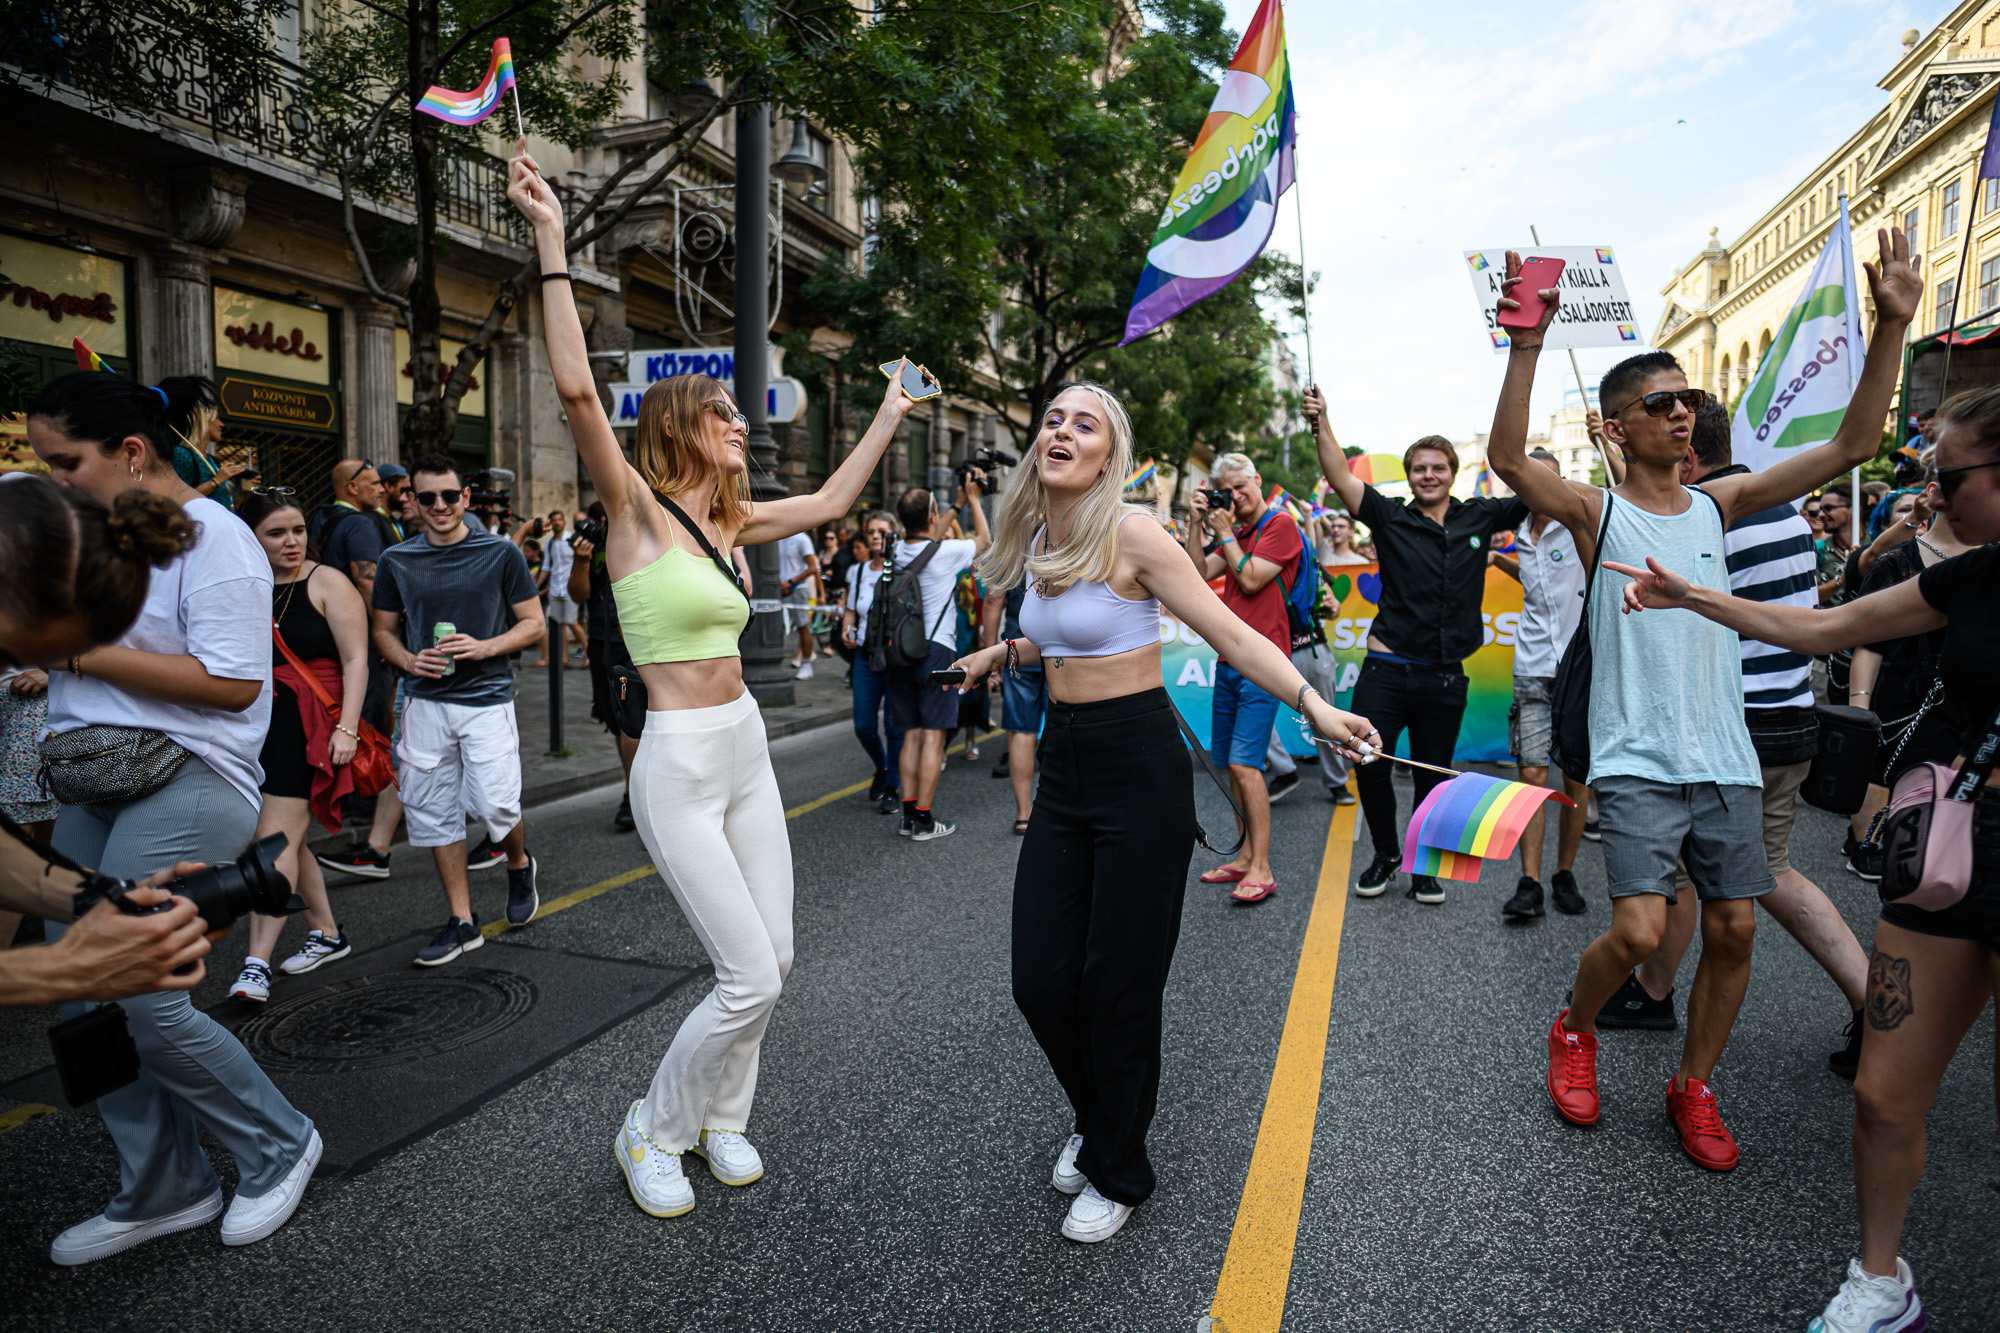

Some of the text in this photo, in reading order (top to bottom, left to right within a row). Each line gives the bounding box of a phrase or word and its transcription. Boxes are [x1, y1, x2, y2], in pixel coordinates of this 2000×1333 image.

[1488, 272, 1499, 293] A
[1565, 261, 1600, 288] KIÁLL
[1600, 268, 1610, 288] A
[1557, 295, 1634, 324] CSALÁDOKÉRT
[646, 353, 735, 383] KÖZPON
[242, 400, 317, 421] ANTIKVÁRIUM
[252, 387, 307, 407] KÖZPONTI
[1953, 771, 1981, 802] FILA
